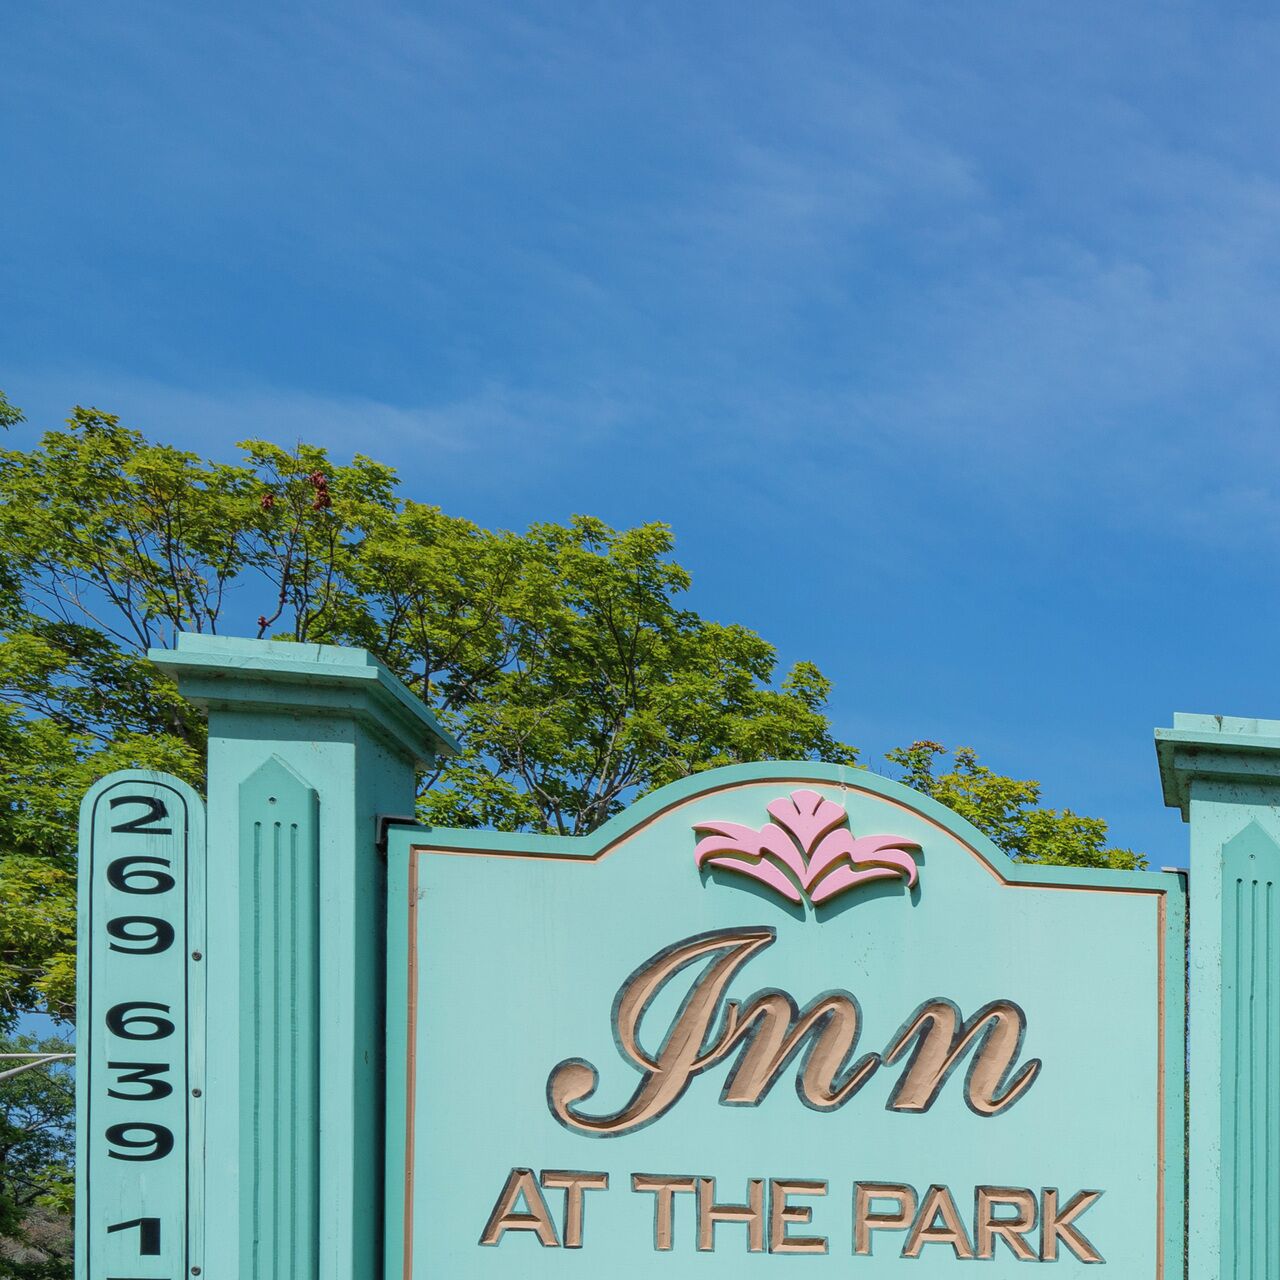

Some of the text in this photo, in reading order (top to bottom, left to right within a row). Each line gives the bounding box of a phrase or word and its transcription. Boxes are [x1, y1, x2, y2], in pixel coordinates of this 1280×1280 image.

[107, 795, 176, 956] 269
[105, 1001, 176, 1163] 639
[546, 925, 1042, 1138] Inn
[478, 1167, 1107, 1265] AT THE PARK
